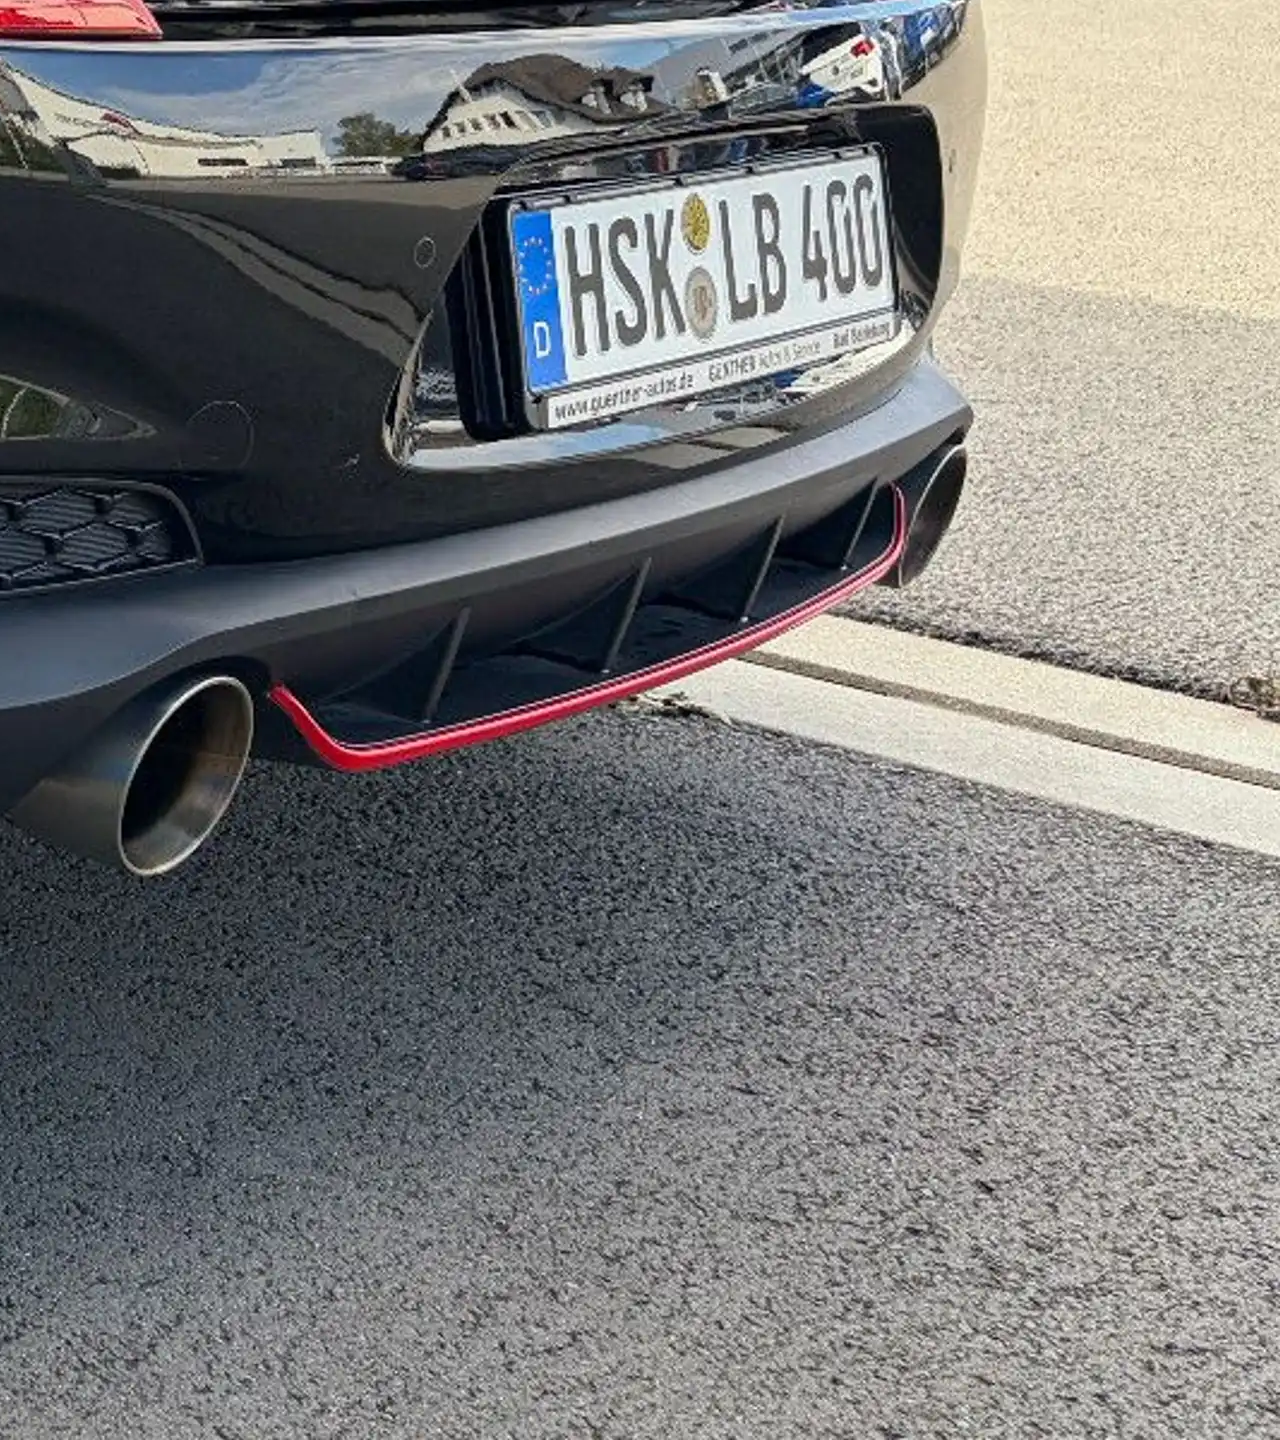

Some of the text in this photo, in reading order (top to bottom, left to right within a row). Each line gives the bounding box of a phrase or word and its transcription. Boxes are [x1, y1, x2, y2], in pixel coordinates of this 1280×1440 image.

[564, 172, 884, 358] HSK LB 400
[533, 321, 551, 358] D
